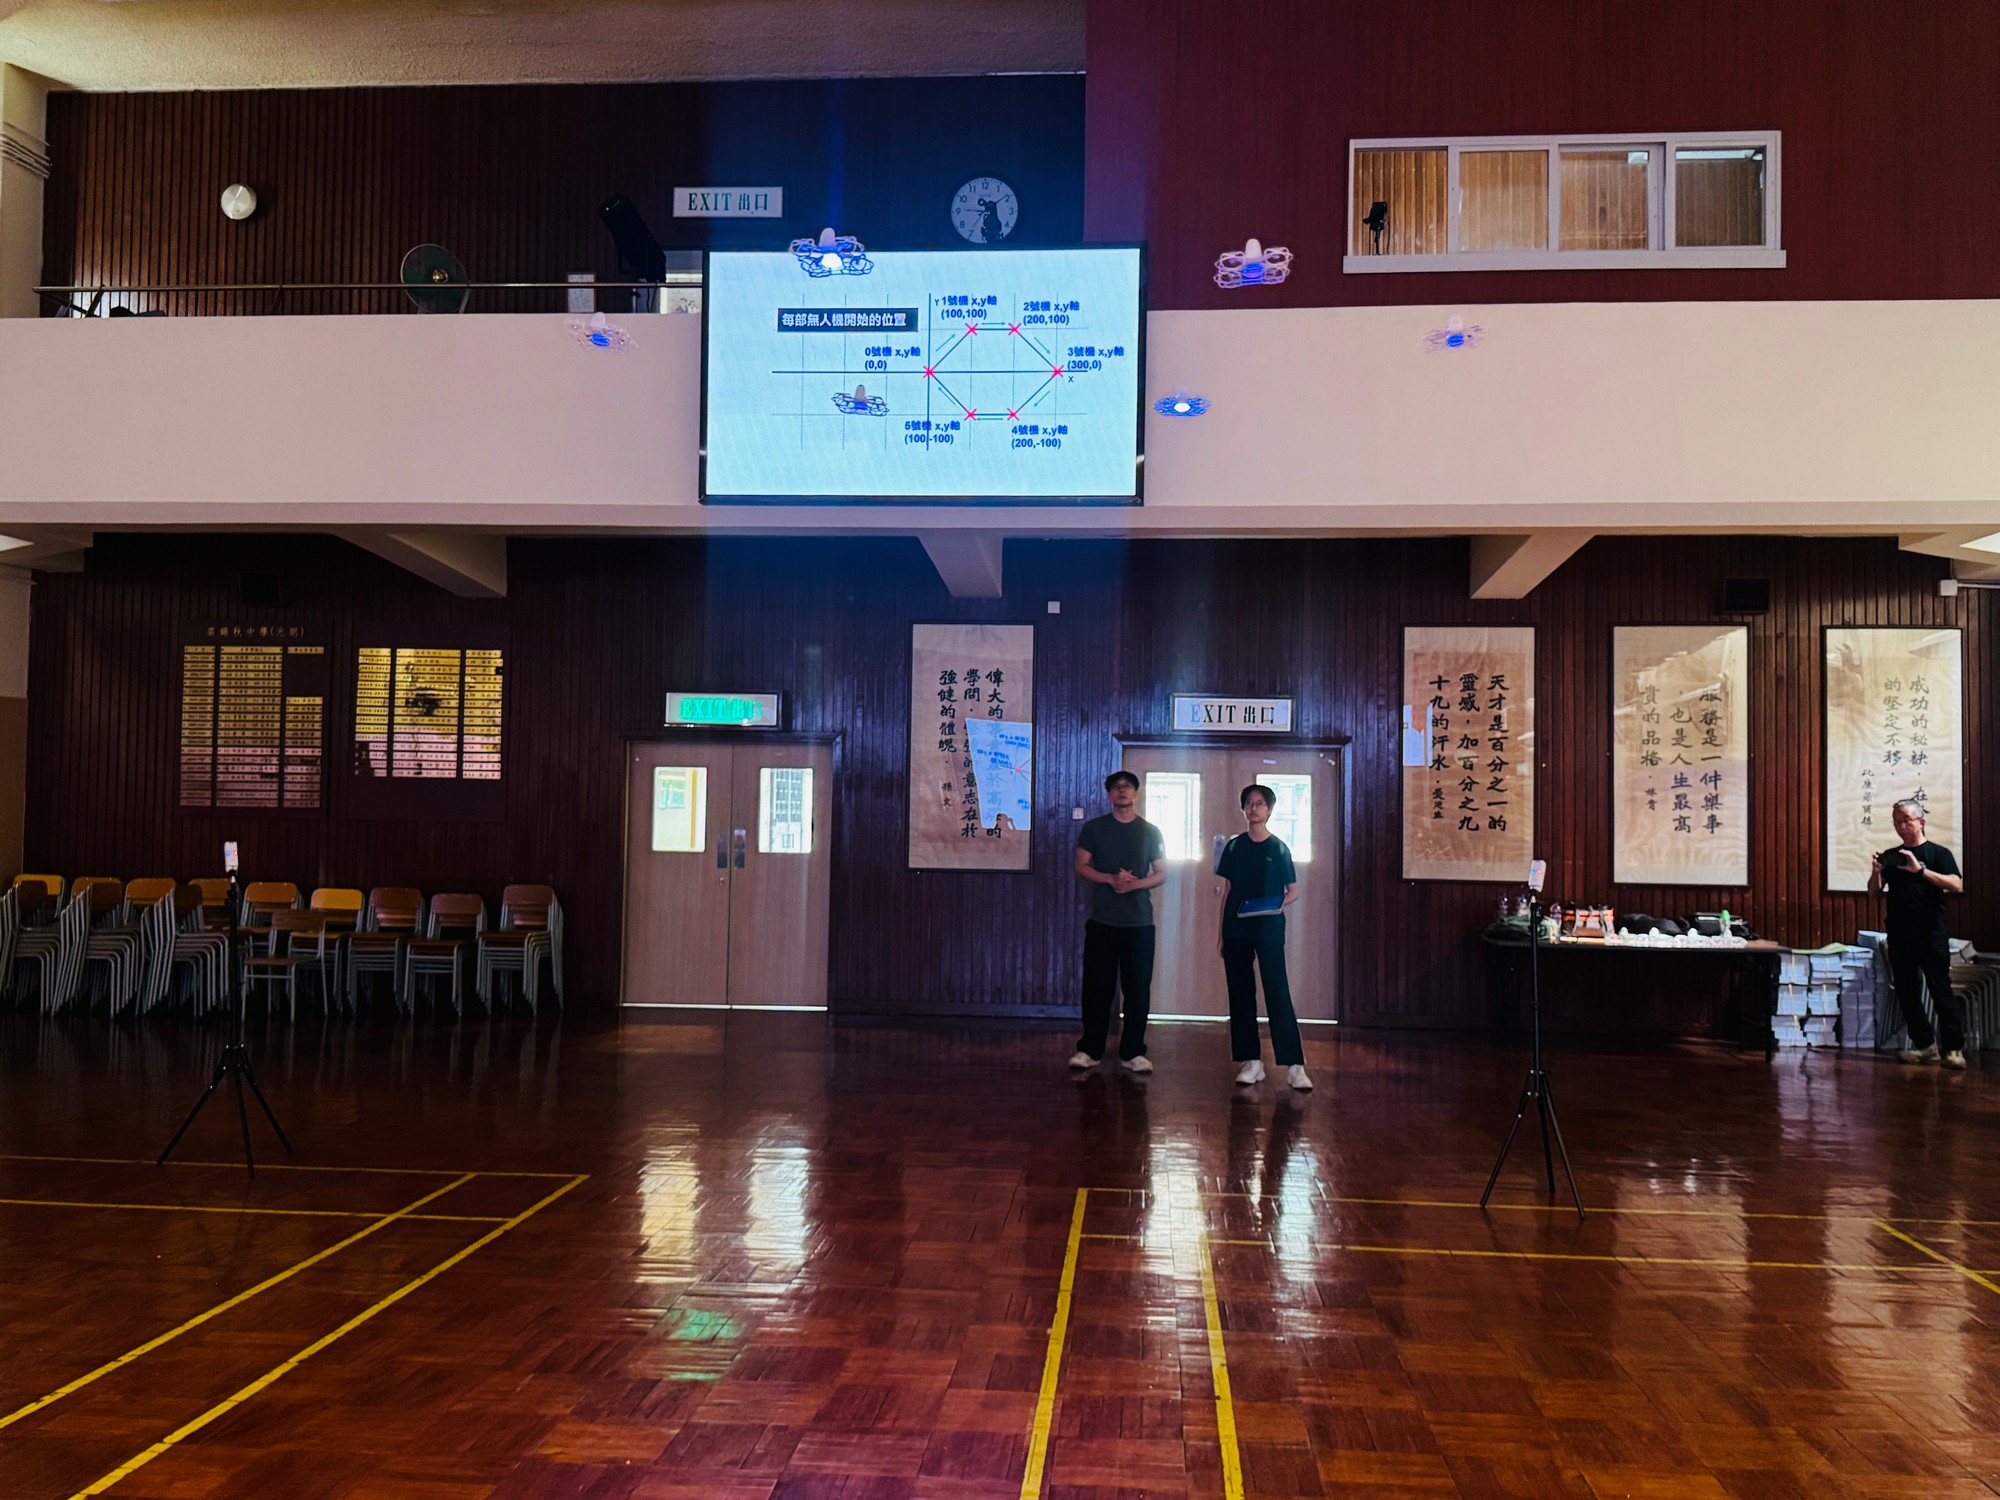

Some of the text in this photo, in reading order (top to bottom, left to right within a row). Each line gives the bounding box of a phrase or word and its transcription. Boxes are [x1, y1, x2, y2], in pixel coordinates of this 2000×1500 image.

[981, 181, 989, 190] 12
[688, 192, 768, 211] EXIT 出口
[959, 195, 967, 203] 10
[1005, 194, 1010, 202] 2
[942, 295, 997, 307] 1號機 x,y軸
[1023, 301, 1080, 313] 2號機 x,y軸
[782, 313, 906, 327] 每部無人機開始的位置
[941, 309, 987, 320] (100,100)
[1023, 315, 1070, 326] (200,100)
[865, 346, 921, 358] 0號機 x,y軸
[1068, 346, 1124, 358] 3號機 x,y軸
[864, 360, 887, 371] (0,0)
[1067, 360, 1102, 371] (300,0)
[904, 421, 961, 432] 5號機 x,y軸
[1011, 425, 1068, 436] 4號機 x,y軸
[1011, 438, 1061, 449] (200,-100)
[681, 698, 726, 719] EXIT
[1190, 703, 1275, 724] EXIT 出口
[1487, 674, 1510, 832] 天才是百分之一的
[1700, 688, 1723, 834] 服務是一件樂事
